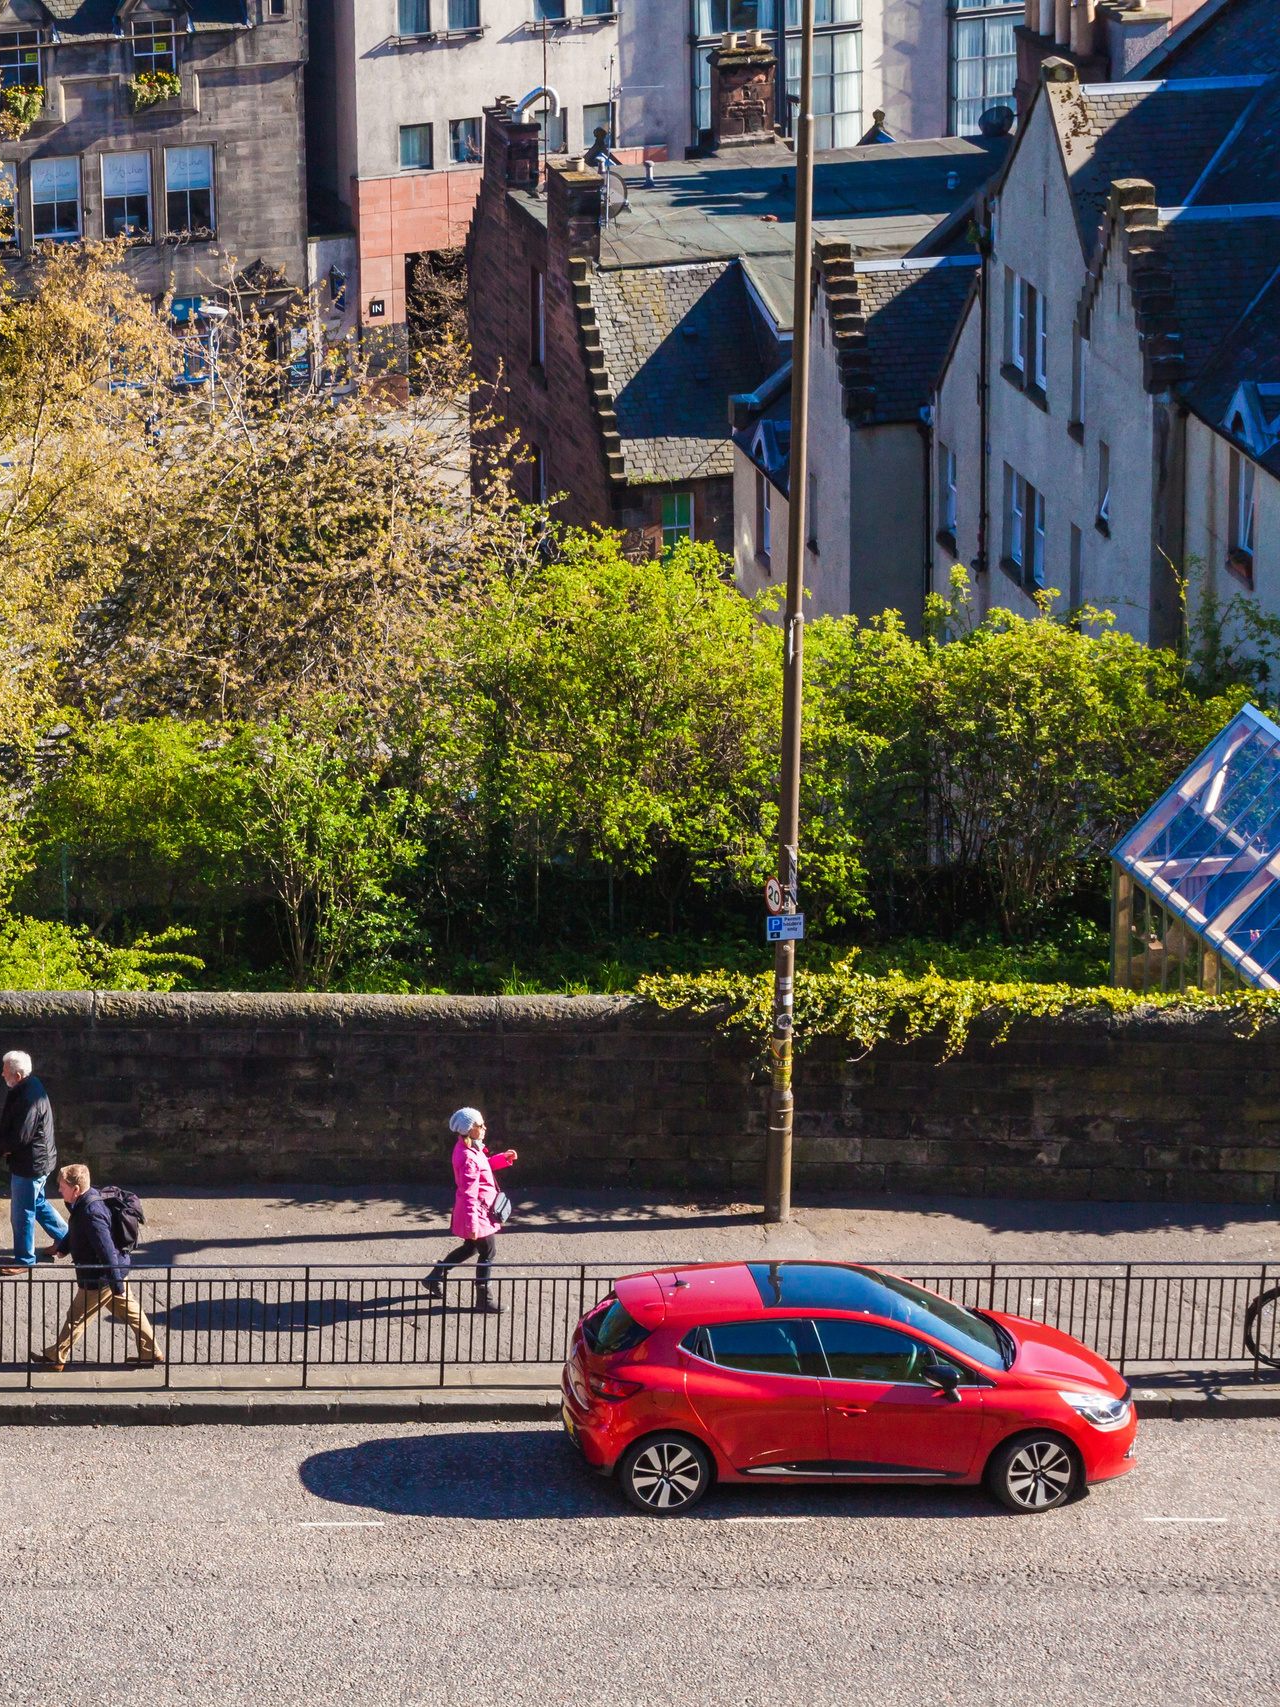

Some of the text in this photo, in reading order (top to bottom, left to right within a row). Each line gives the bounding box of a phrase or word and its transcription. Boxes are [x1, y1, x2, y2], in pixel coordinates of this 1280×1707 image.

[372, 304, 383, 313] IN
[768, 886, 780, 905] 20
[772, 919, 780, 930] P
